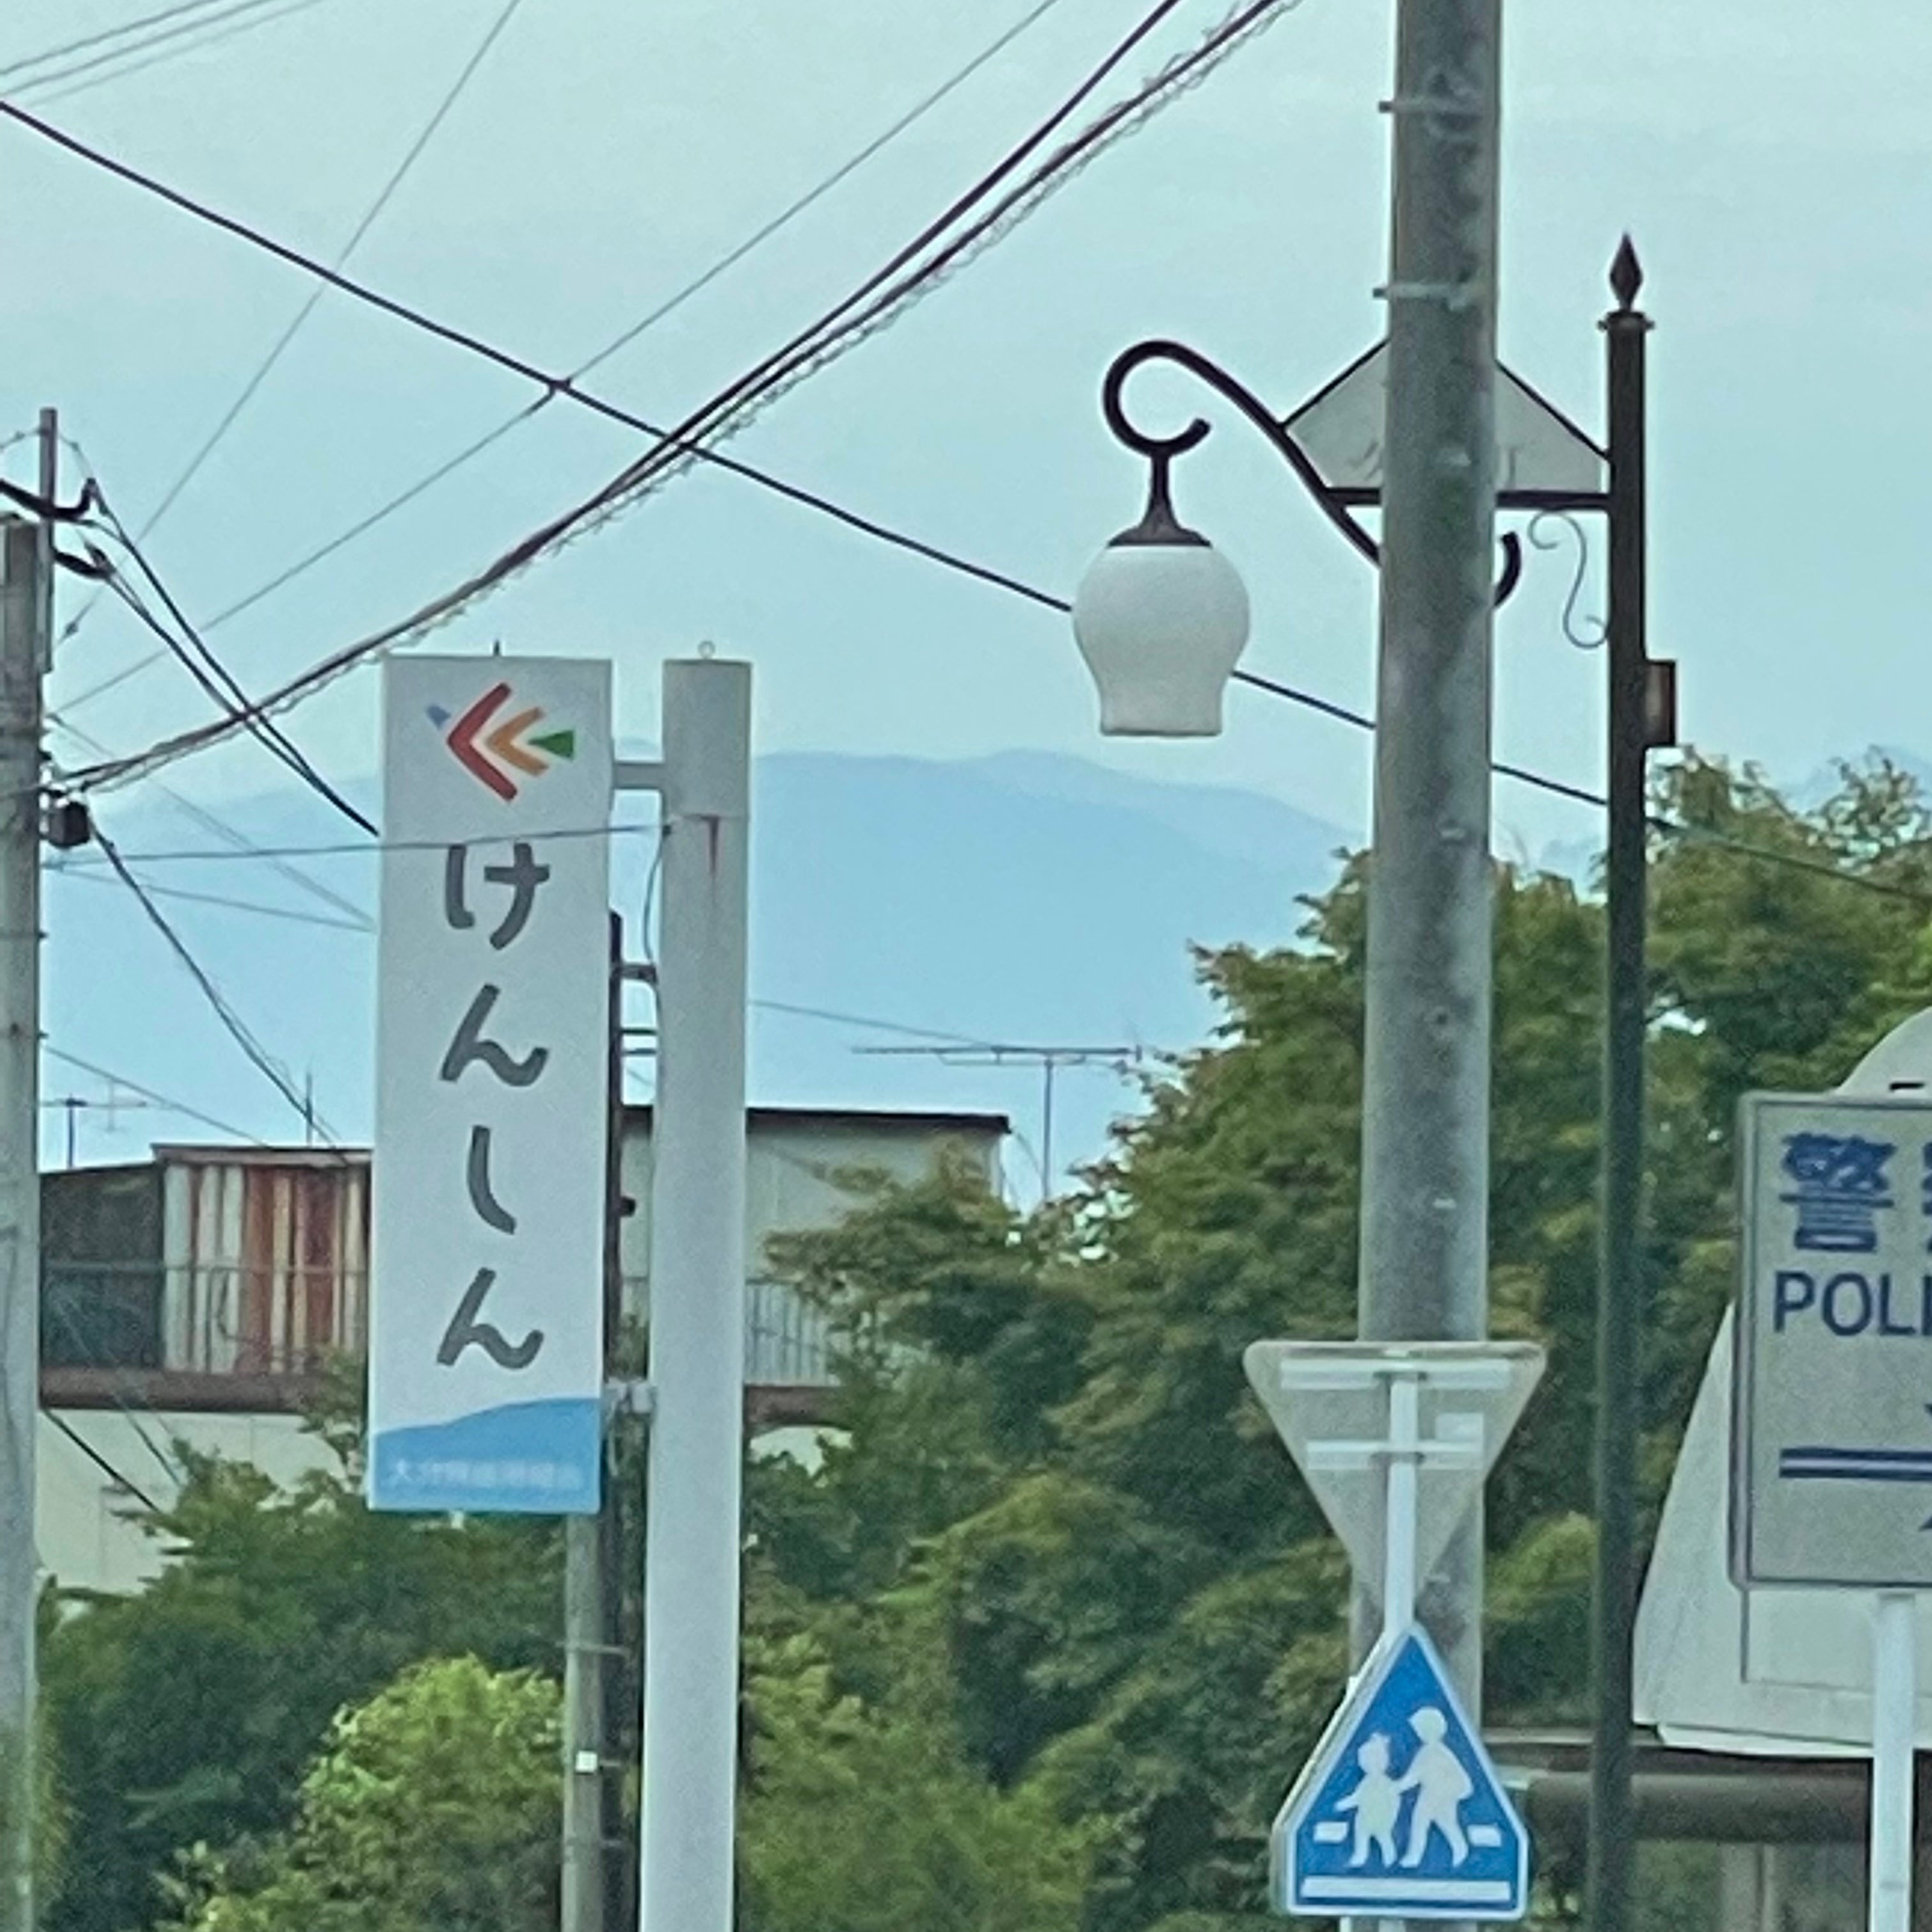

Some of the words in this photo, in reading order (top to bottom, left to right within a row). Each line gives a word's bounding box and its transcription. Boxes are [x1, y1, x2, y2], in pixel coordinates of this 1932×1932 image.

[438, 843, 551, 1369] けんしん
[1780, 1132, 1932, 1253] 警
